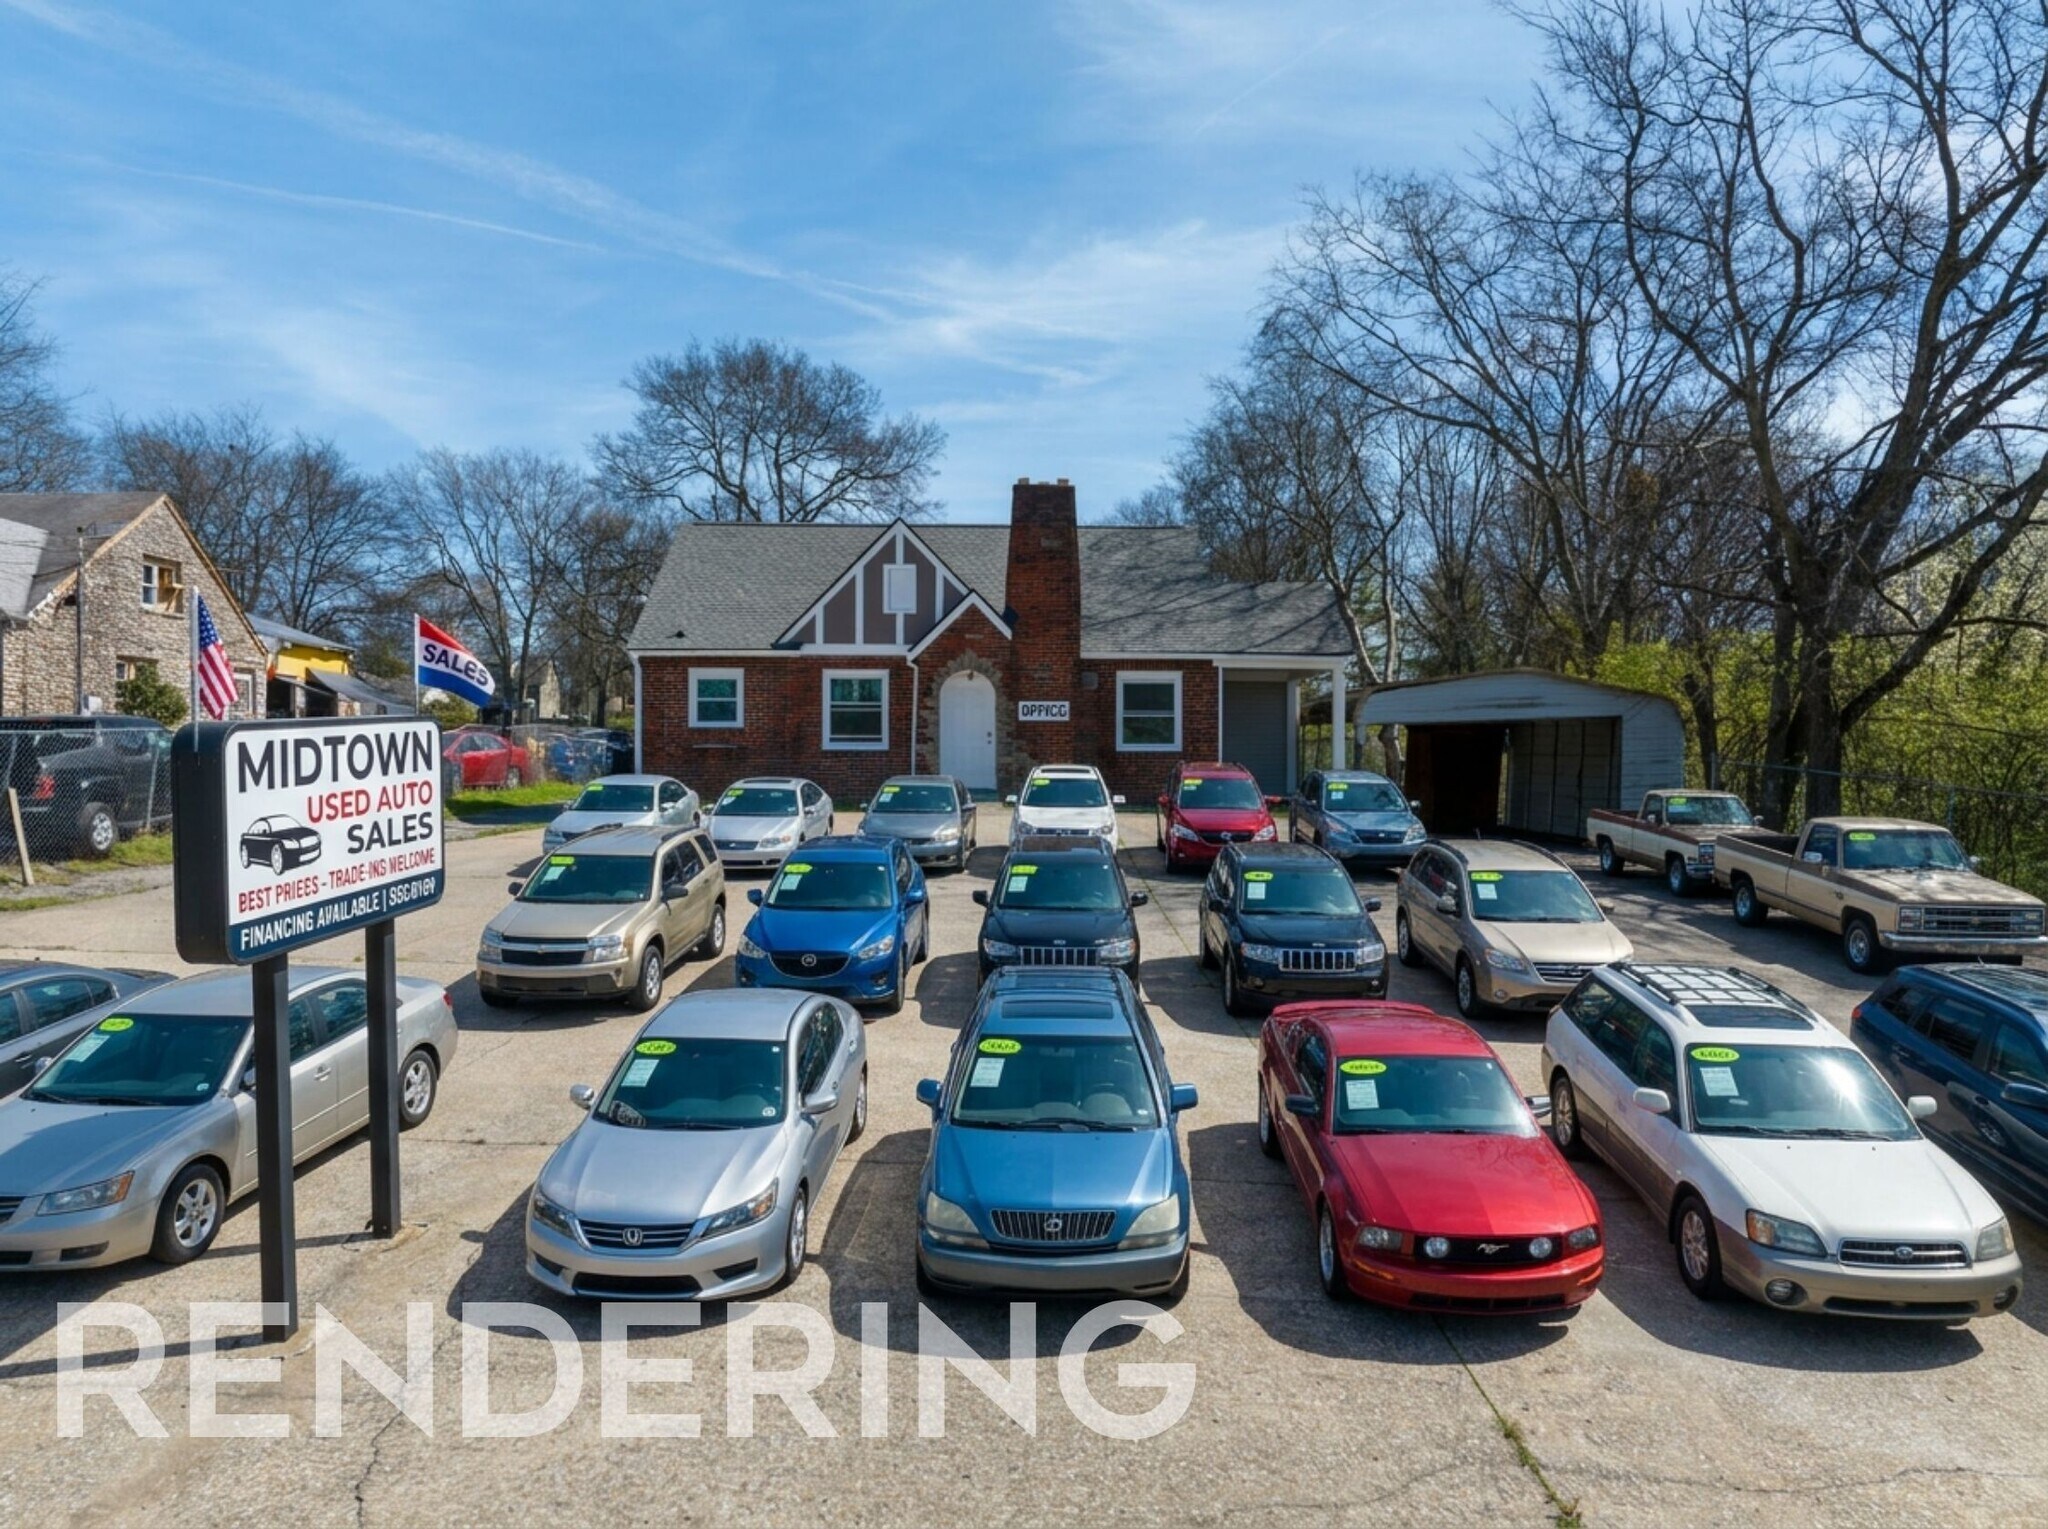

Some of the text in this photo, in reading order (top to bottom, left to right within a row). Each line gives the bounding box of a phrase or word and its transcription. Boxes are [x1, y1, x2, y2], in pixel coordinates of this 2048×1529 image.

[423, 643, 489, 686] SALES
[238, 730, 432, 793] MIDTOWN
[307, 780, 433, 823] USED AUTO
[347, 811, 433, 854] SALES
[239, 886, 272, 913] BEST
[241, 910, 314, 951] FINANCING
